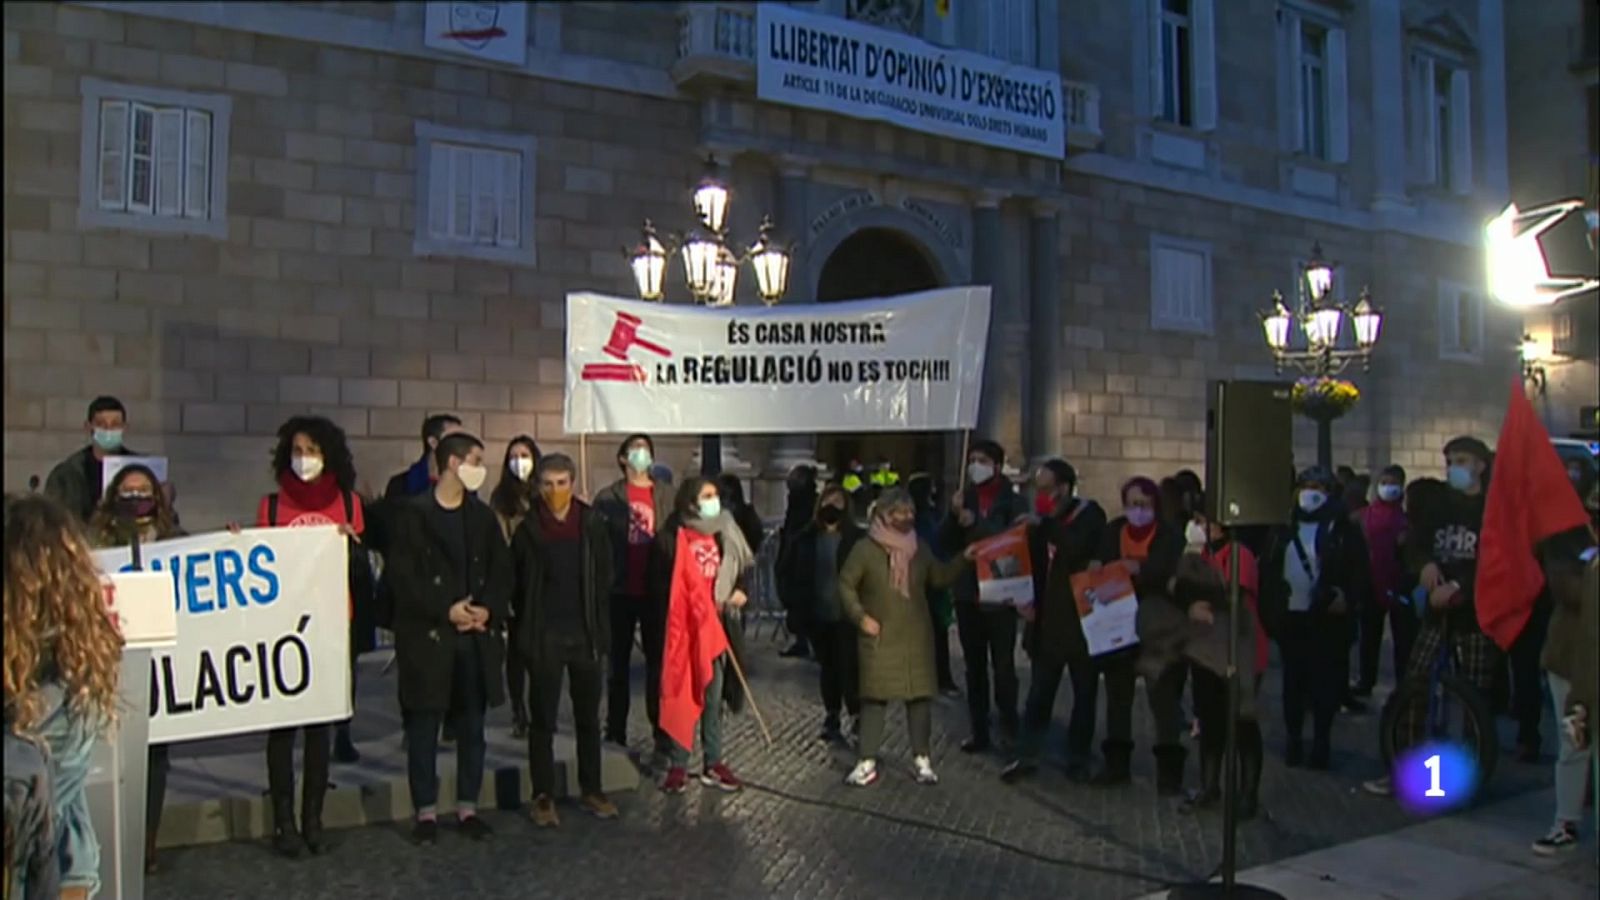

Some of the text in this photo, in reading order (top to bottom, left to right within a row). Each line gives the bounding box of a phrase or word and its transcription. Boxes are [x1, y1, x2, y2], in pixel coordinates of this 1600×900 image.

[769, 22, 1056, 120] LLIBERTAT D'OPINIÓ I D'EXPRESSIÓ
[783, 72, 820, 95] ARTICLE
[836, 83, 849, 100] DE
[850, 85, 861, 102] LA
[728, 318, 887, 345] ÉS CASA NOSTRA
[656, 362, 678, 384] LA
[683, 349, 823, 385] REGULACIÓ
[828, 361, 853, 383] NO
[858, 360, 881, 383] ES
